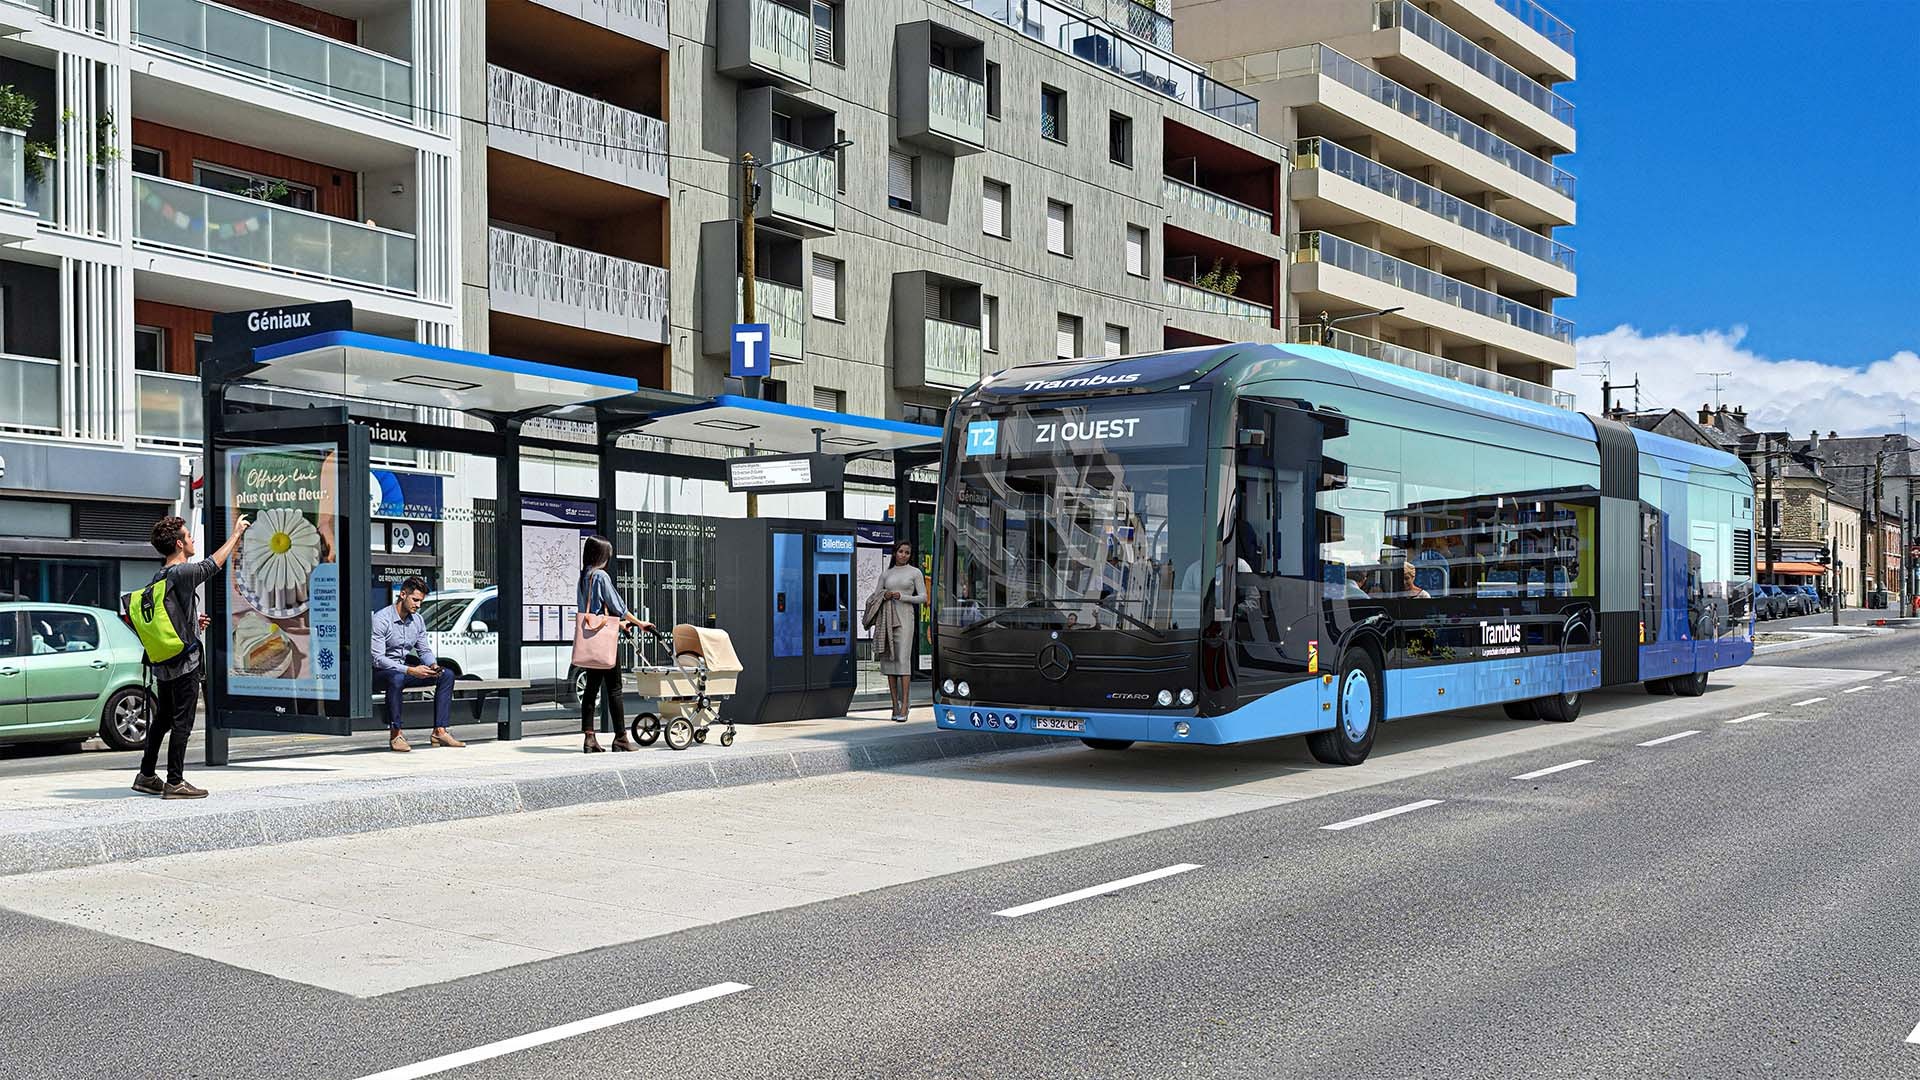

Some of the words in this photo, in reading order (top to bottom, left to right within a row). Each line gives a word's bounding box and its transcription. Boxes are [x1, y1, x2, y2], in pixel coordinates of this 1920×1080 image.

[247, 310, 312, 332] Géniaux
[735, 331, 763, 368] T
[1023, 373, 1142, 391] Trambus
[970, 427, 995, 448] T2
[1035, 423, 1057, 443] ZI
[1061, 418, 1140, 441] OUEST
[247, 468, 318, 488] Offrez-lui
[236, 491, 258, 508] plus
[259, 489, 297, 506] qu'une
[298, 487, 330, 501] fleur.
[416, 532, 430, 546] 90
[822, 538, 853, 549] Billetterie
[404, 568, 422, 576] SERVICE
[1480, 619, 1521, 645] Trambus
[1050, 719, 1066, 729] 924
